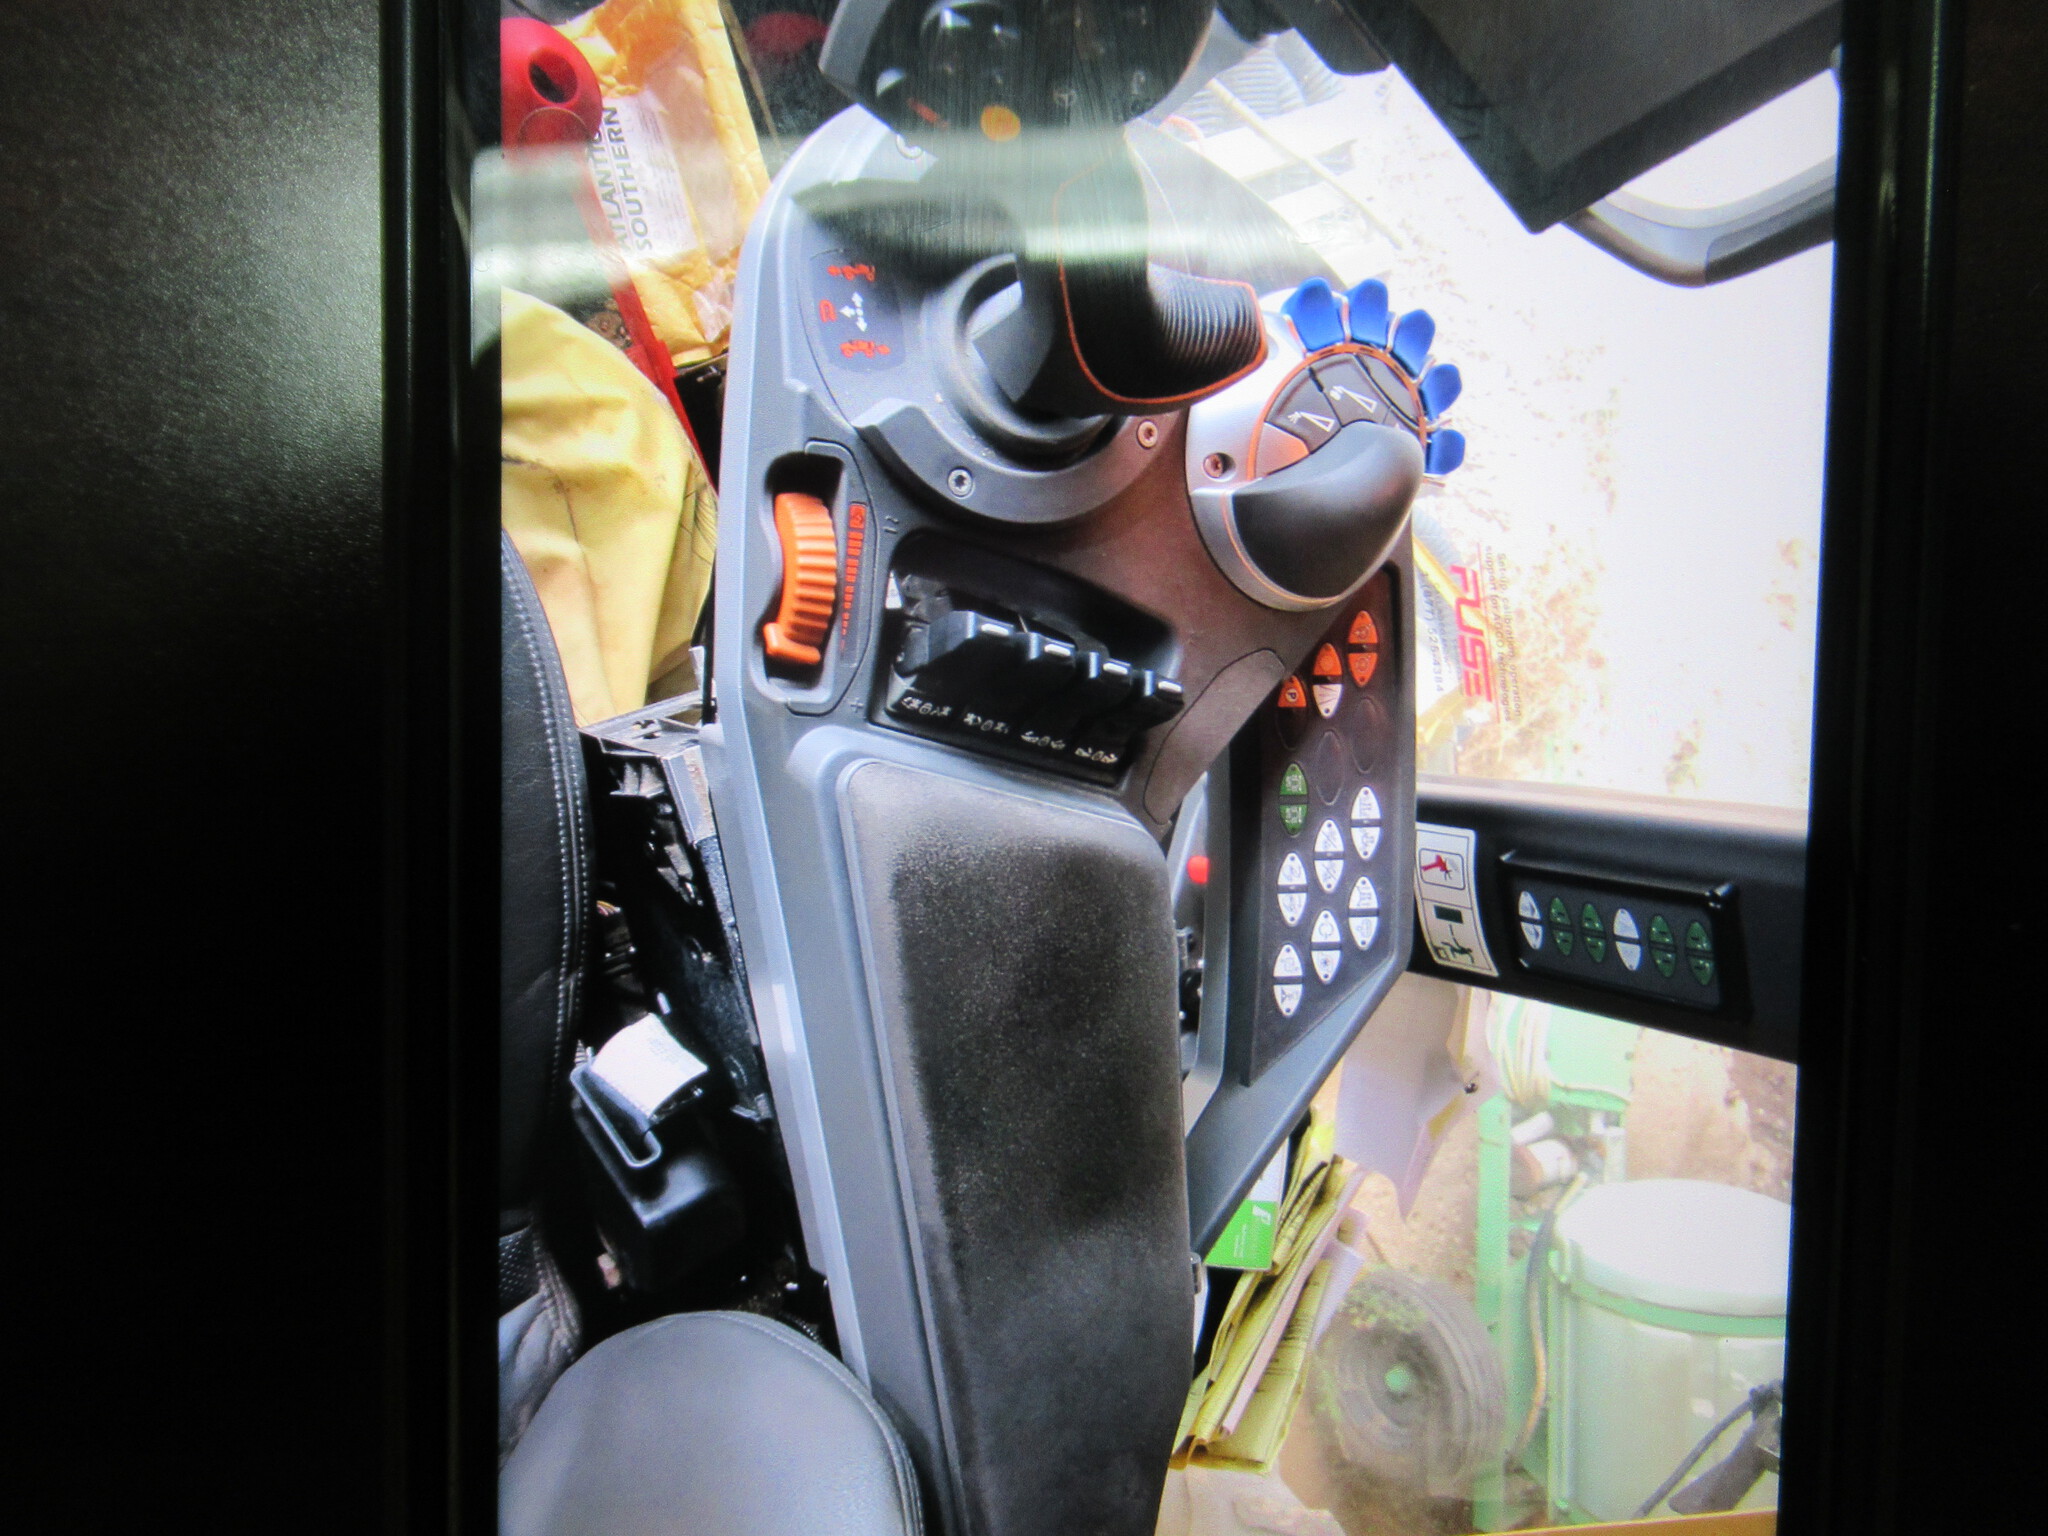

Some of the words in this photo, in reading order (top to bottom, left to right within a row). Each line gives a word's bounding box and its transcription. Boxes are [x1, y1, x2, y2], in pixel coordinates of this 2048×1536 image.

[603, 106, 652, 250] SOUTHERN
[1450, 565, 1493, 702] FUSE
[1485, 546, 1496, 591] support
[1491, 593, 1500, 611] for
